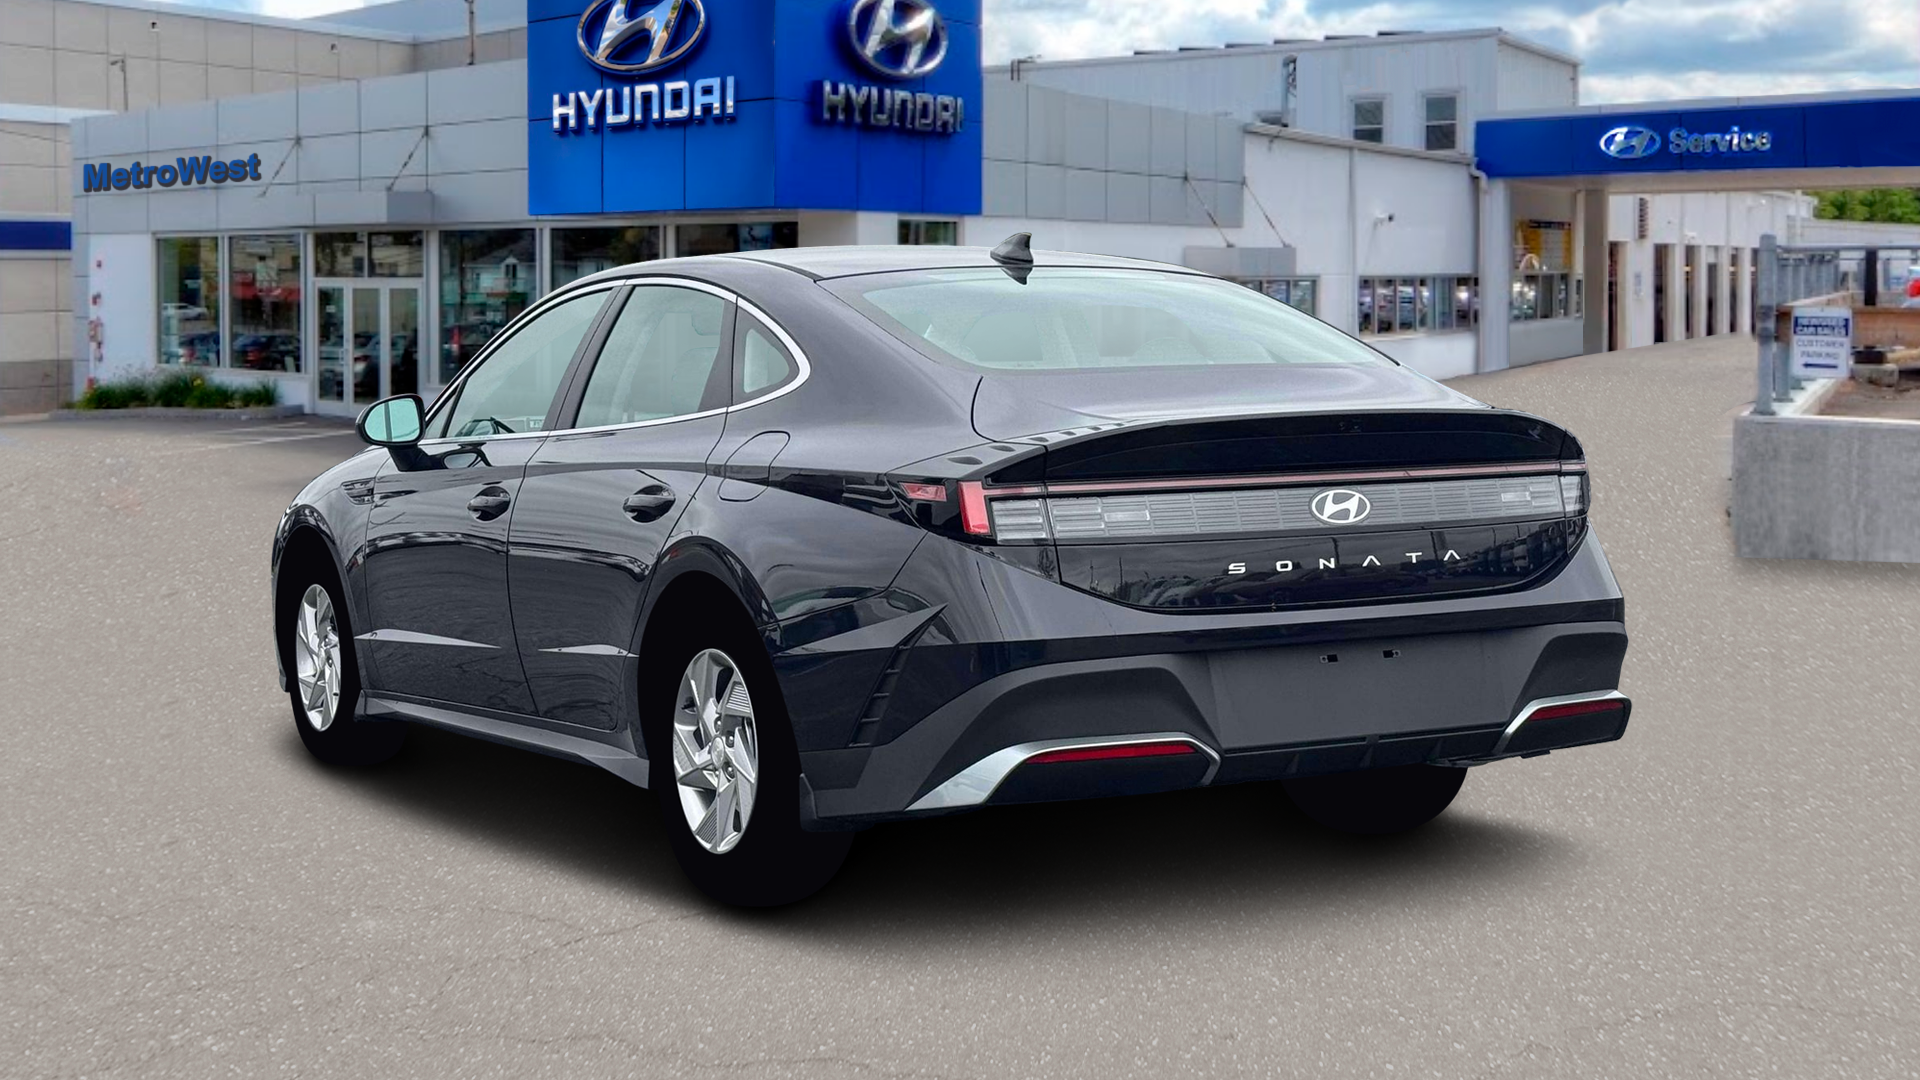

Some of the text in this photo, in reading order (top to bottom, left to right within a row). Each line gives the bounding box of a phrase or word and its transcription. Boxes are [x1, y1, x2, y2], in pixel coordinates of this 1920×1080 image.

[552, 75, 735, 130] HYUNDAI
[823, 80, 964, 133] HYUNDAI
[1668, 125, 1771, 153] Service
[83, 152, 262, 193] MetroWest
[1796, 339, 1844, 348] CUSTOMER
[1799, 350, 1840, 360] PARKING
[1228, 549, 1461, 575] SONATA
